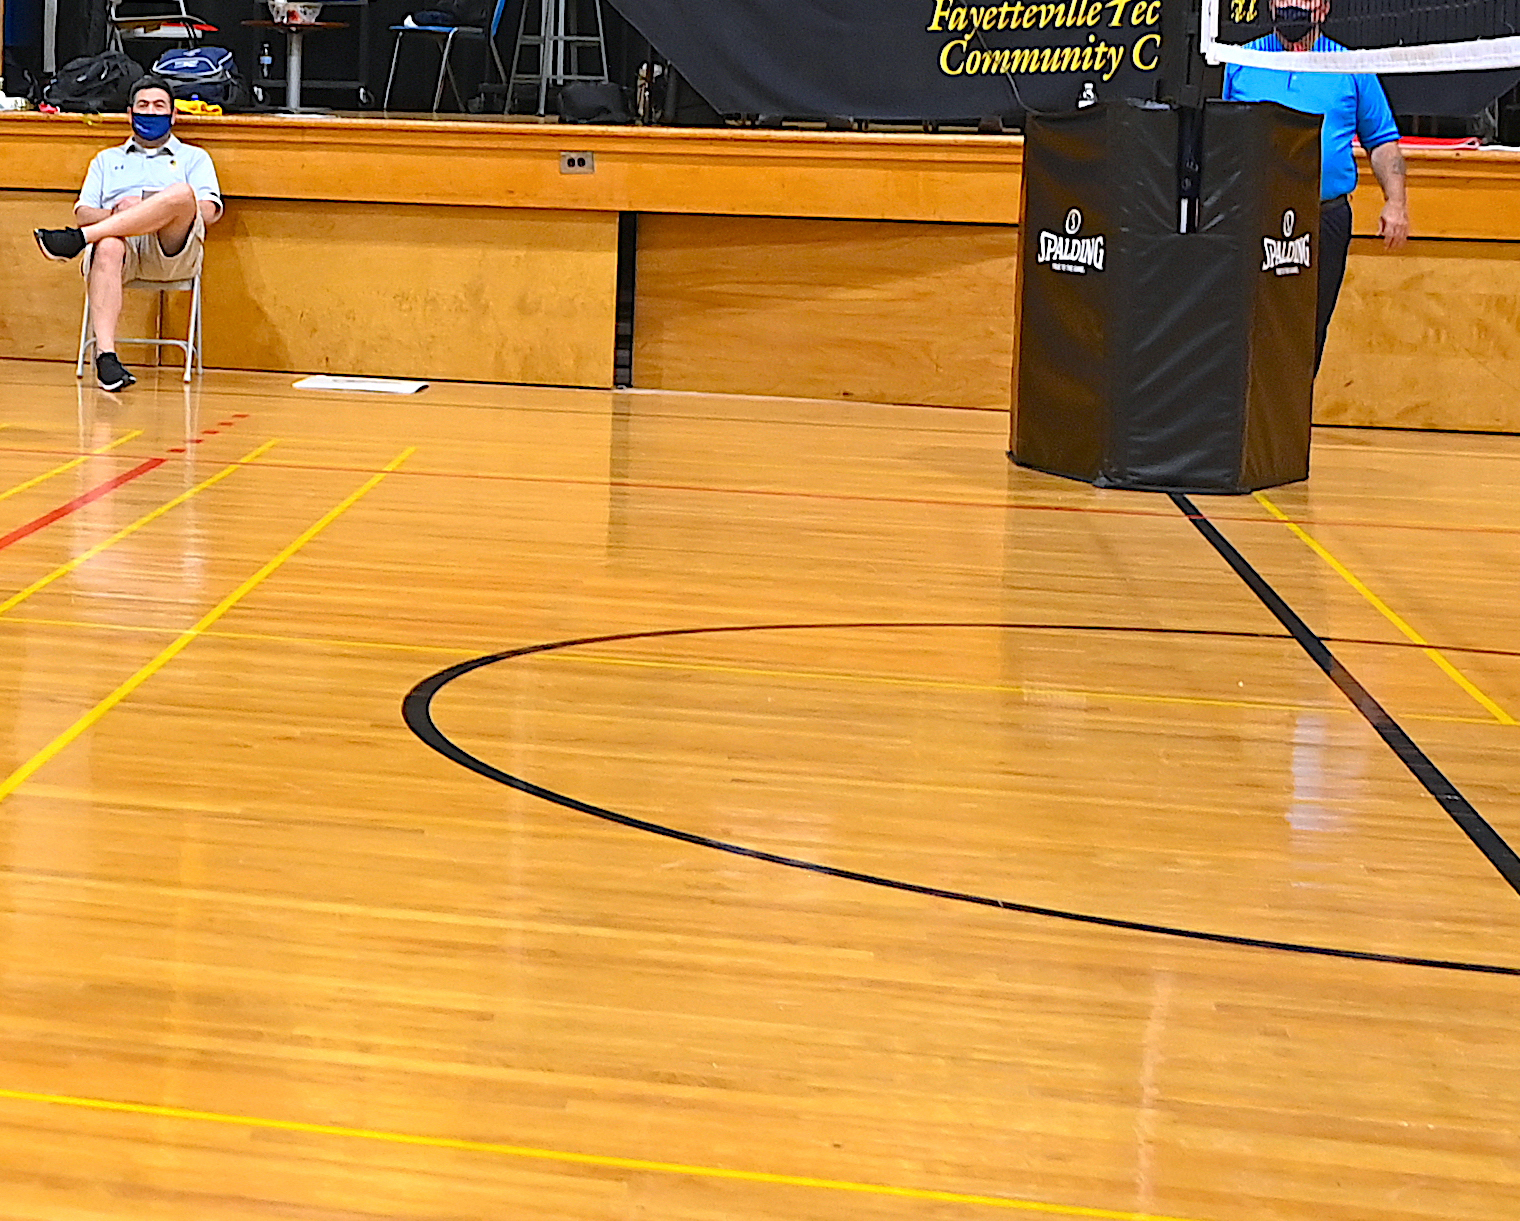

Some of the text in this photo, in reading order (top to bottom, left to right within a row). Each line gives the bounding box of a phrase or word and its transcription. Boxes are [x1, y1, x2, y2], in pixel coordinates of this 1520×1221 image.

[939, 34, 1125, 81] Community
[1038, 231, 1104, 270] SPALDING
[1262, 233, 1310, 271] SPALDING
